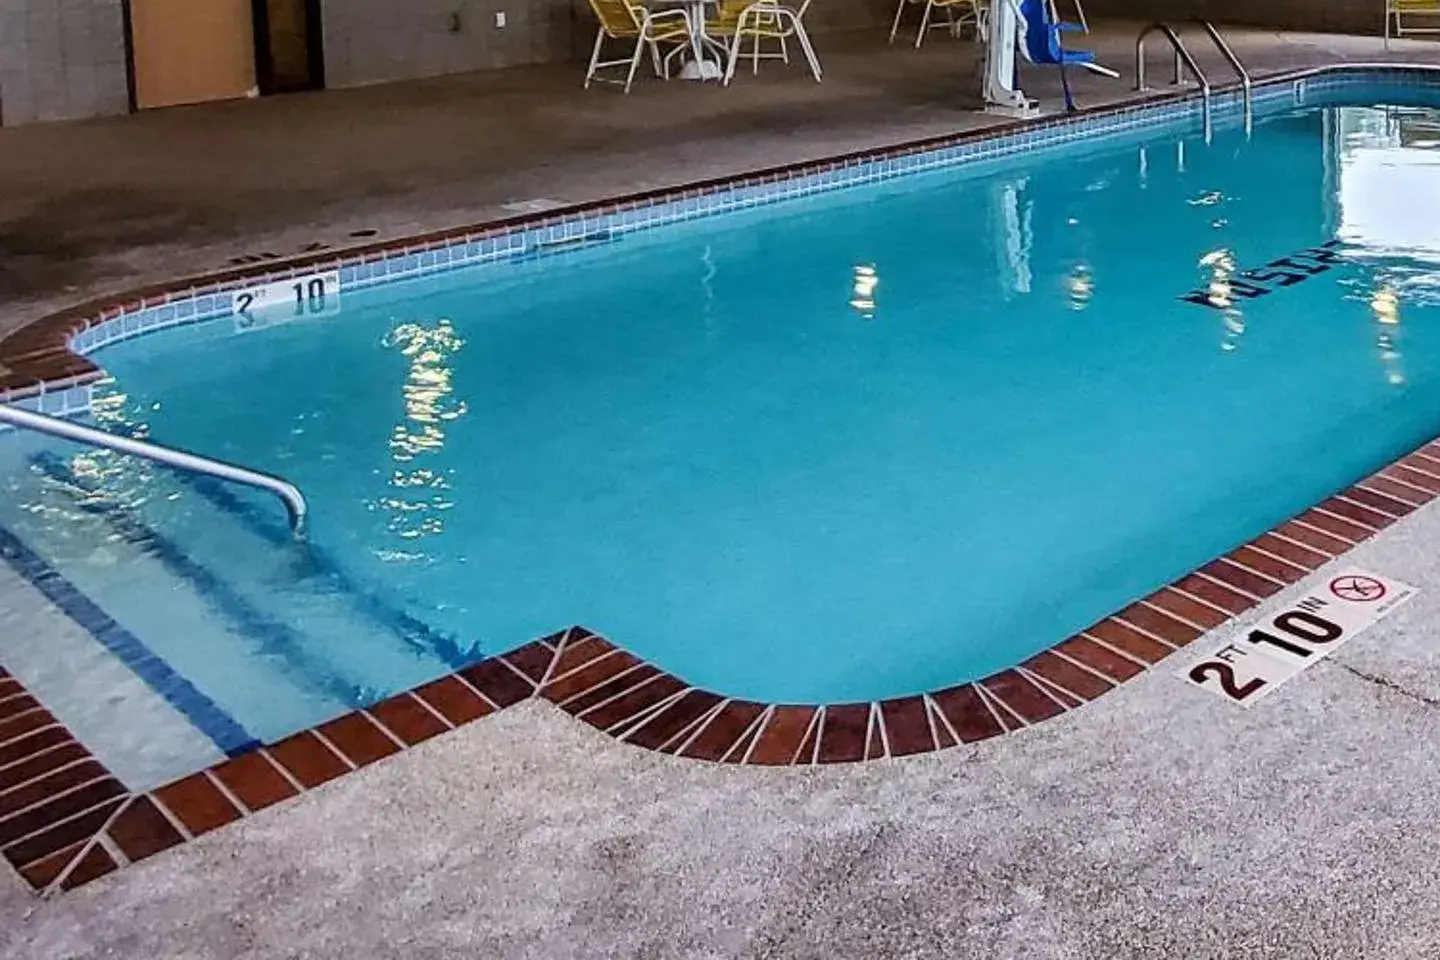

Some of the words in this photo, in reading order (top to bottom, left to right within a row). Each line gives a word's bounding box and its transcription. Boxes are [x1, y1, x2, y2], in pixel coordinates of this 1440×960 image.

[237, 293, 254, 314] 2
[293, 278, 325, 304] 10
[1296, 596, 1329, 613] IN
[1247, 610, 1343, 658] 10
[1215, 644, 1247, 664] FT
[1188, 661, 1268, 701] 2
